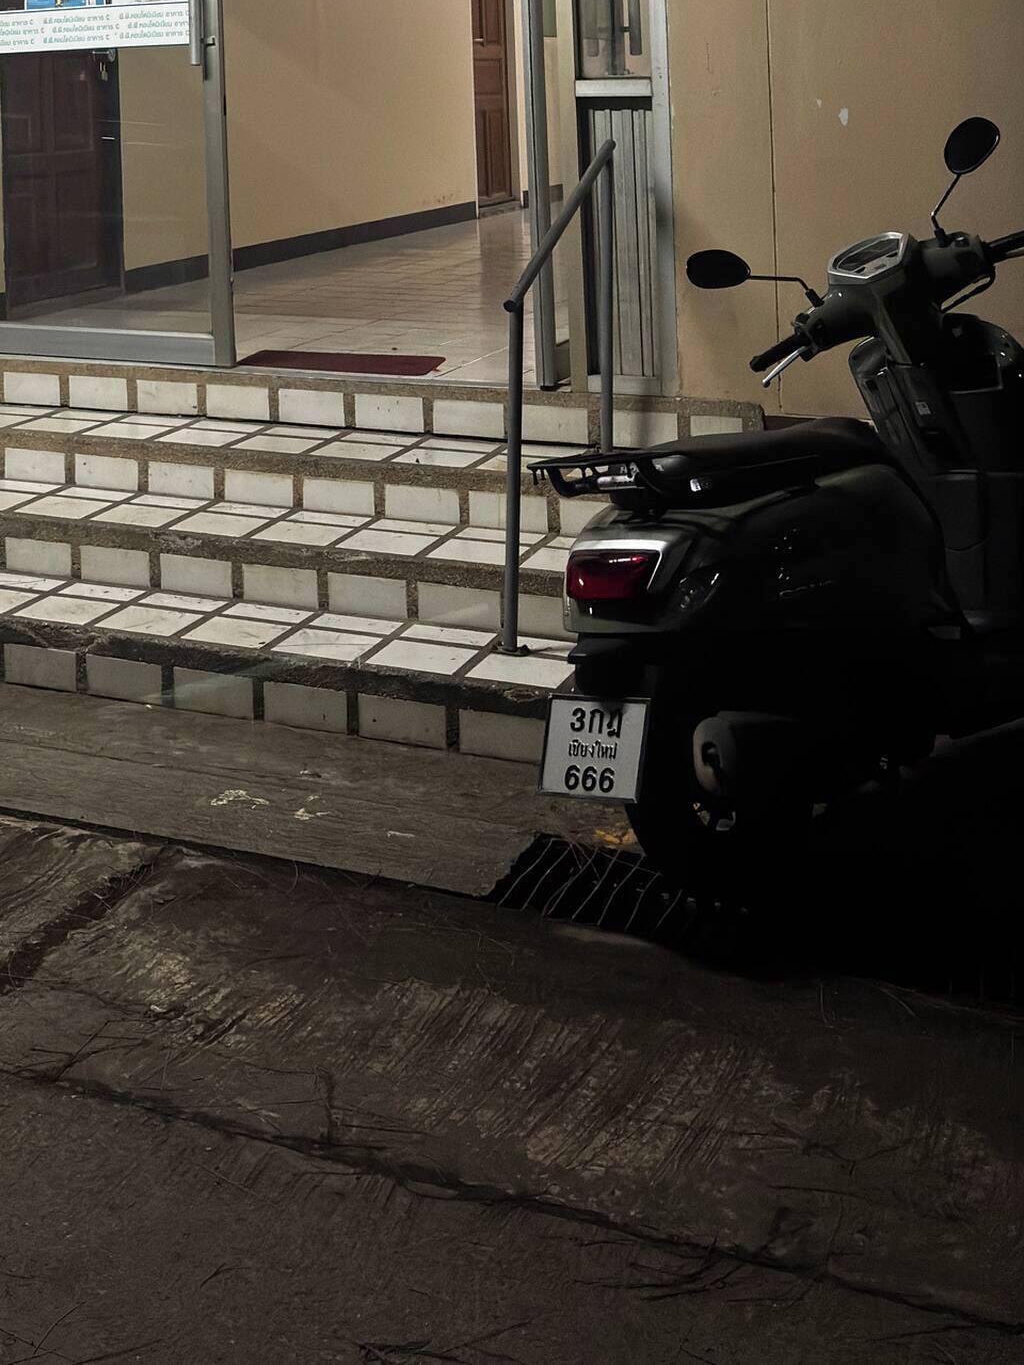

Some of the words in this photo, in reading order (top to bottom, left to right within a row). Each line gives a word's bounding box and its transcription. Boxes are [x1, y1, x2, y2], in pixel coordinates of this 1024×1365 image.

[568, 739, 618, 760] เชียงใหม่
[564, 764, 615, 793] 666
